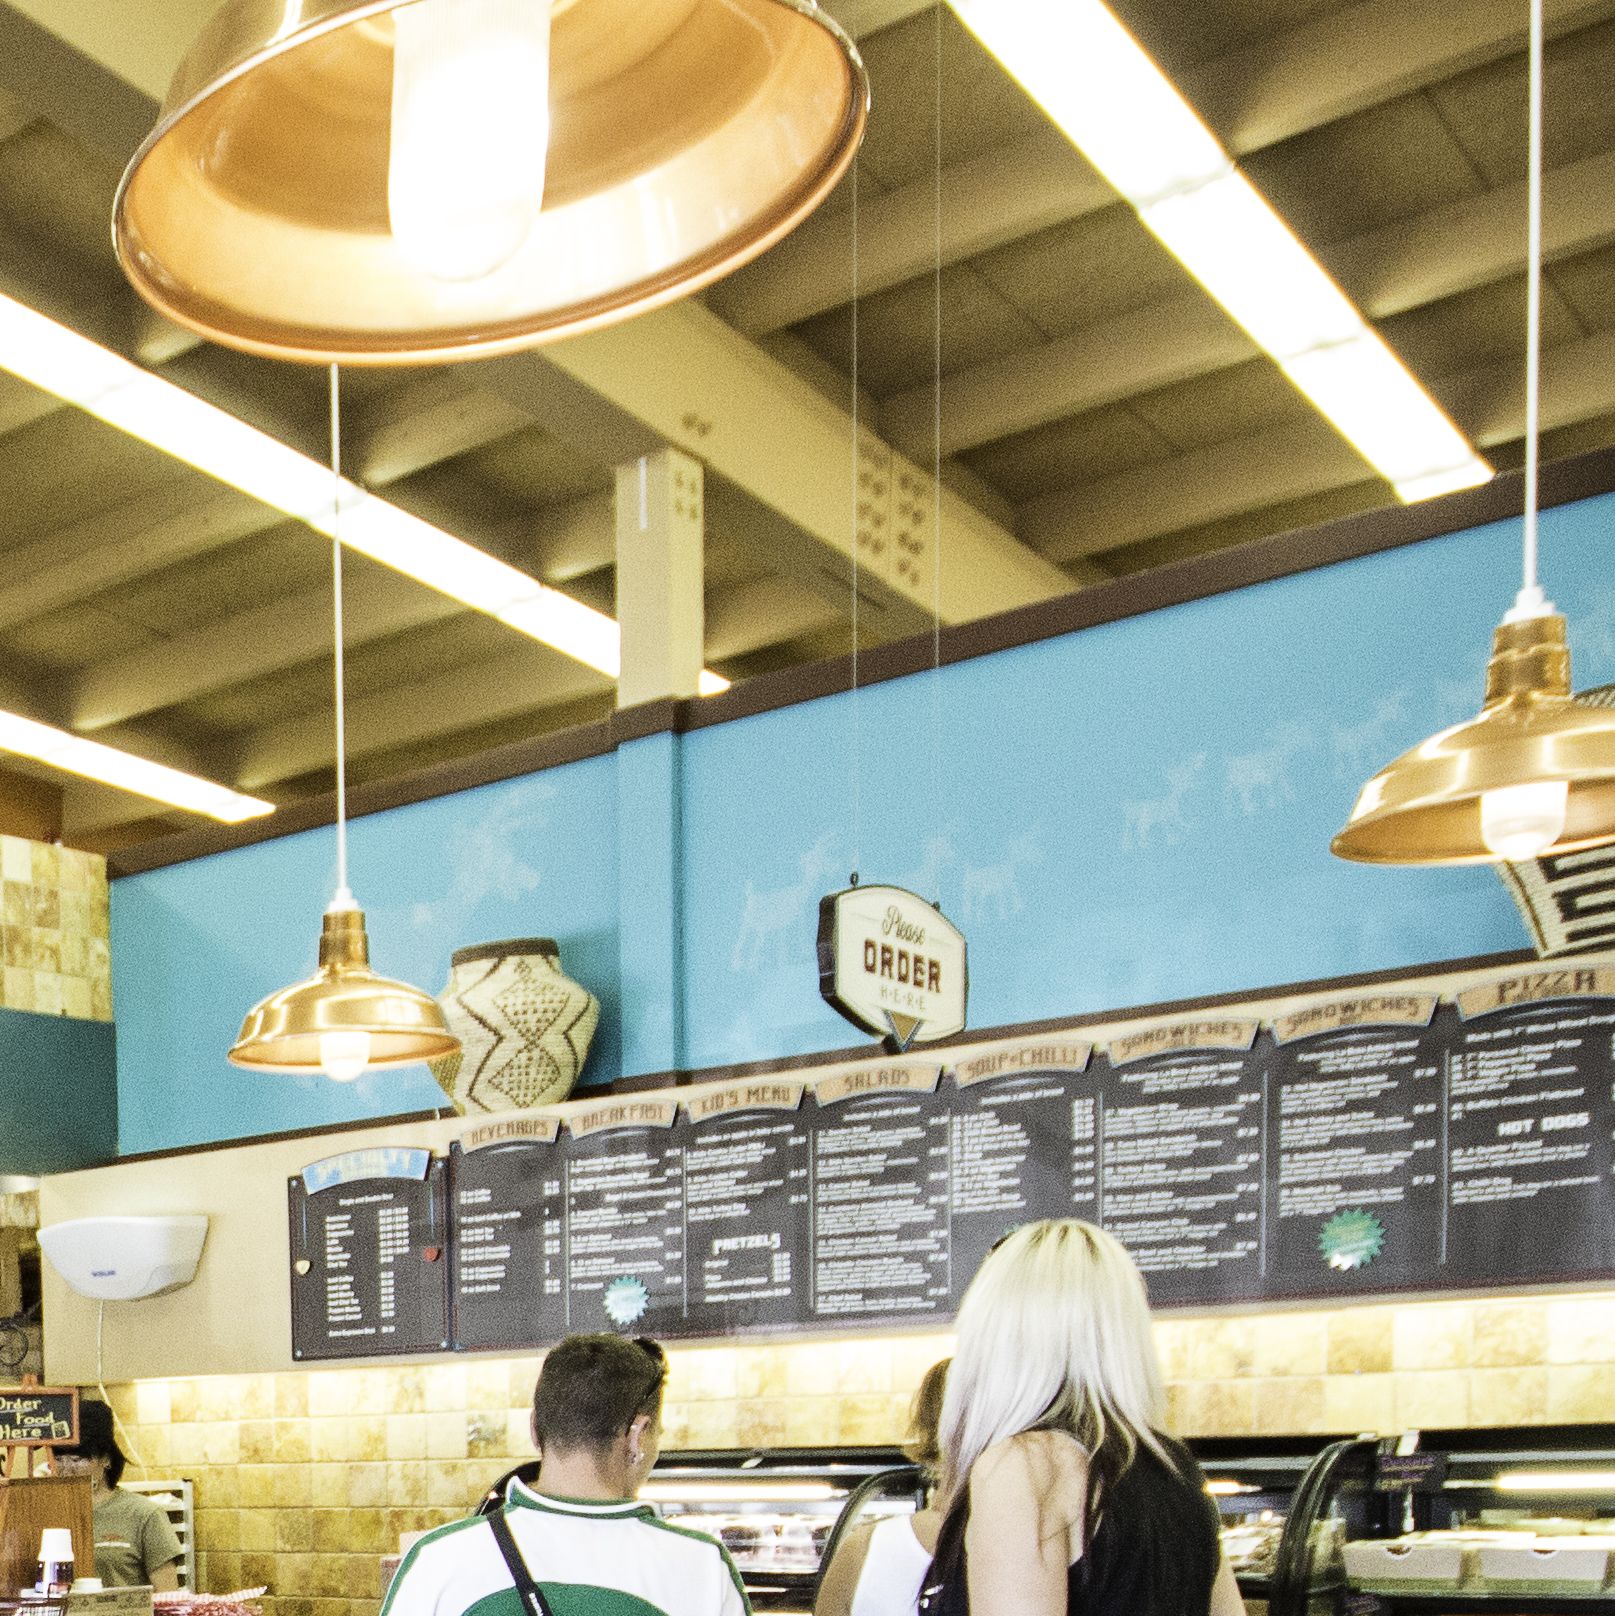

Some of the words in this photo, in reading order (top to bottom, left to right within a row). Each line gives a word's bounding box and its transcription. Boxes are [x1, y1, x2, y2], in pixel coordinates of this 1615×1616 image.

[864, 938, 941, 993] ORDER
[1497, 969, 1597, 1003] PIZZA
[1285, 996, 1421, 1034] SANDWICHES
[1118, 1021, 1244, 1056] SANDWICHES
[746, 1084, 791, 1102] MENU
[844, 1068, 911, 1092] SALADS
[583, 1102, 664, 1131] BREAKFAST
[1498, 1119, 1535, 1137] HOT
[1540, 1111, 1591, 1132] DOGS
[471, 1119, 549, 1145] BEVERAGES
[16, 1411, 55, 1425] Food
